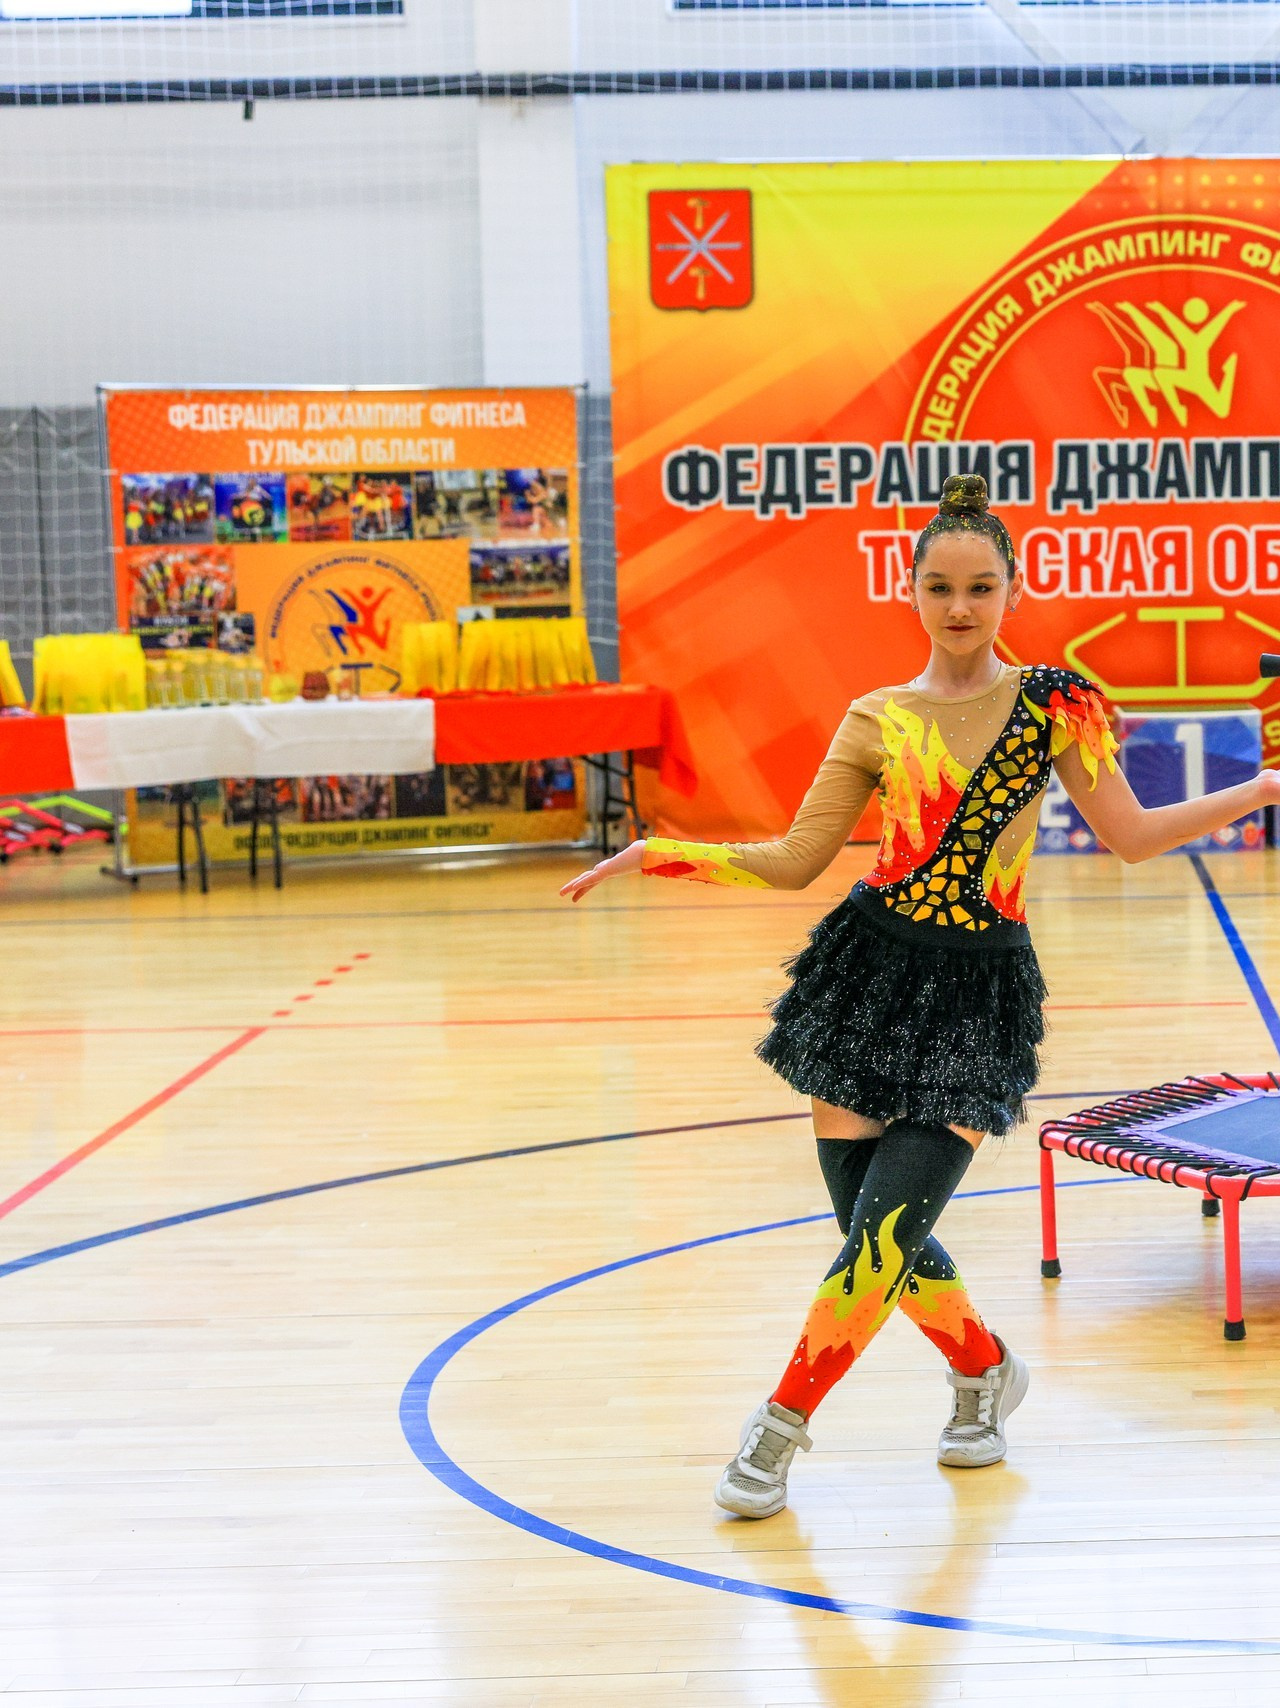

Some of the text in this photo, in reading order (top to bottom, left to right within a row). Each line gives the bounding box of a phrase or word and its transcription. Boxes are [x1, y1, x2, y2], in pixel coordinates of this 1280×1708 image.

[921, 294, 1023, 442] ДЕРАЦИЯ
[1025, 228, 1231, 308] ДЖАМПИНГ
[168, 401, 526, 432] ФЕДЕРАЦИЯ ДЖАМПИНГ ФИТНЕСА
[247, 436, 455, 466] ТУЛЬСКОЙ ОБЛАСТИ
[664, 441, 1034, 518] ФЕДЕРАЦИЯ
[1174, 723, 1206, 801] 1
